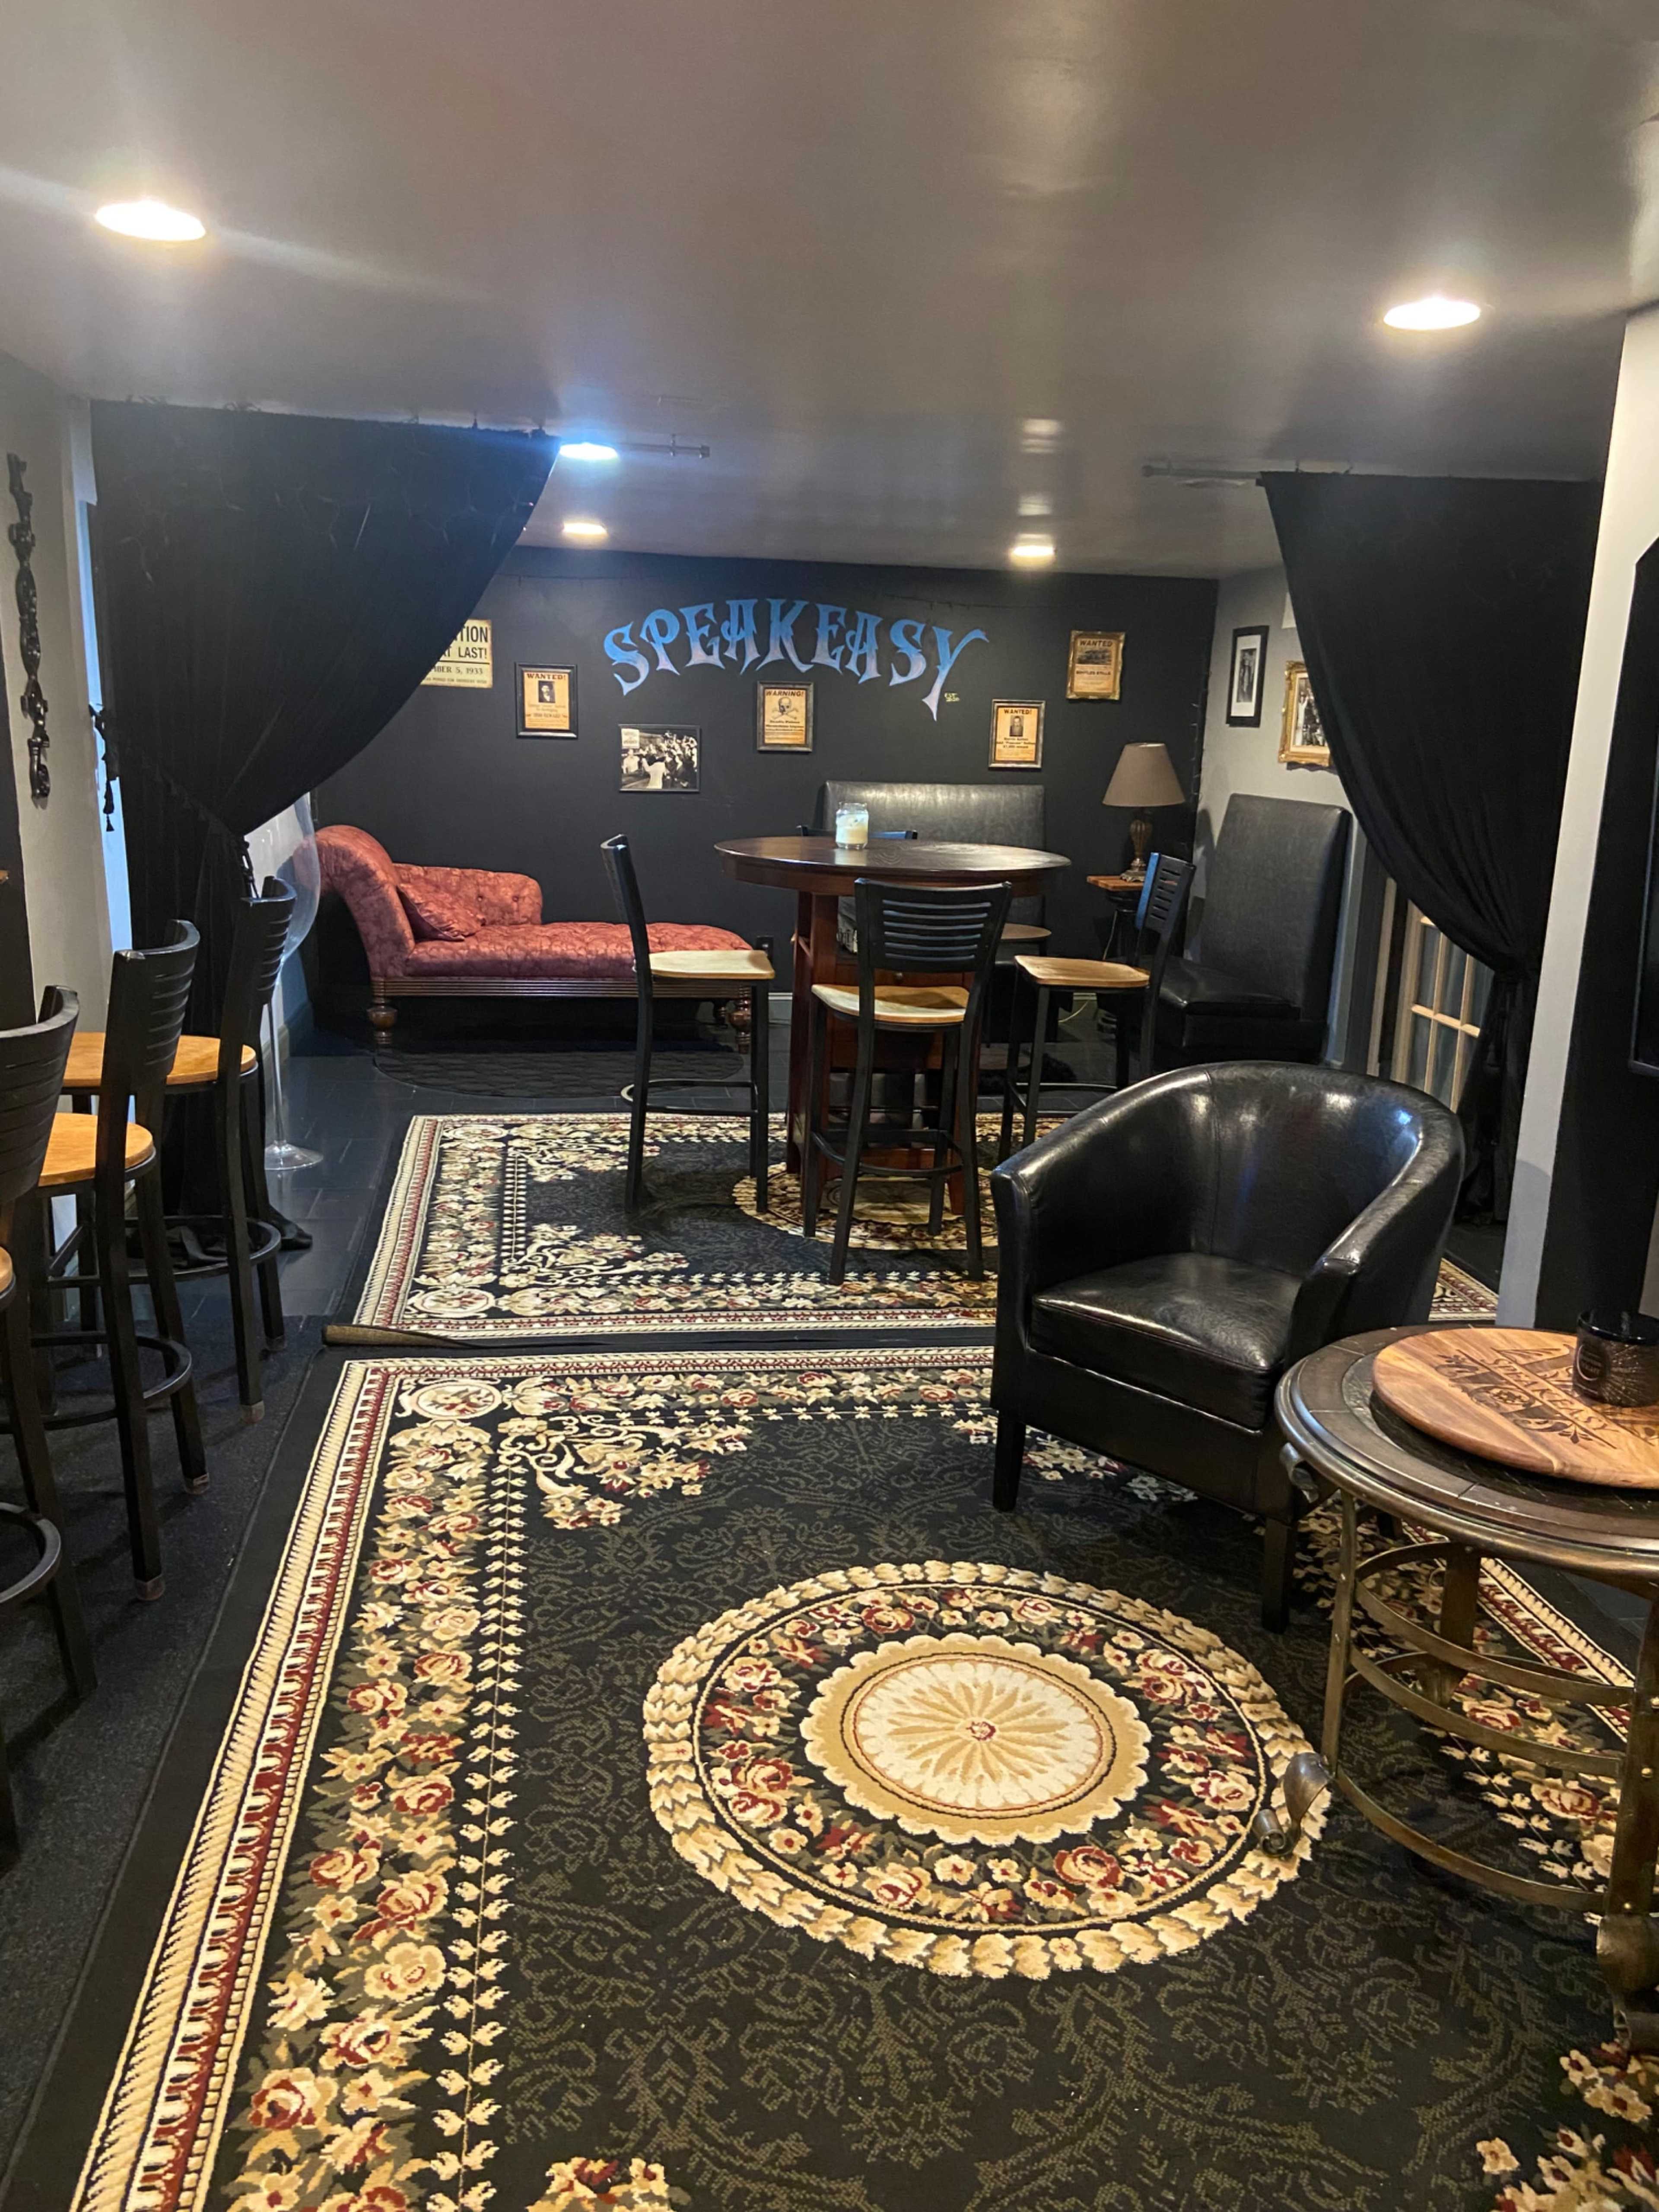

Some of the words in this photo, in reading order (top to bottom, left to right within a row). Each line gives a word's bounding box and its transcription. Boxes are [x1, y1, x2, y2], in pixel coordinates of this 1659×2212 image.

[455, 626, 488, 642] TION
[458, 647, 487, 658] LAST!
[604, 598, 989, 721] SPEAKEASY
[1480, 1358, 1621, 1433] SPEAKEASY
